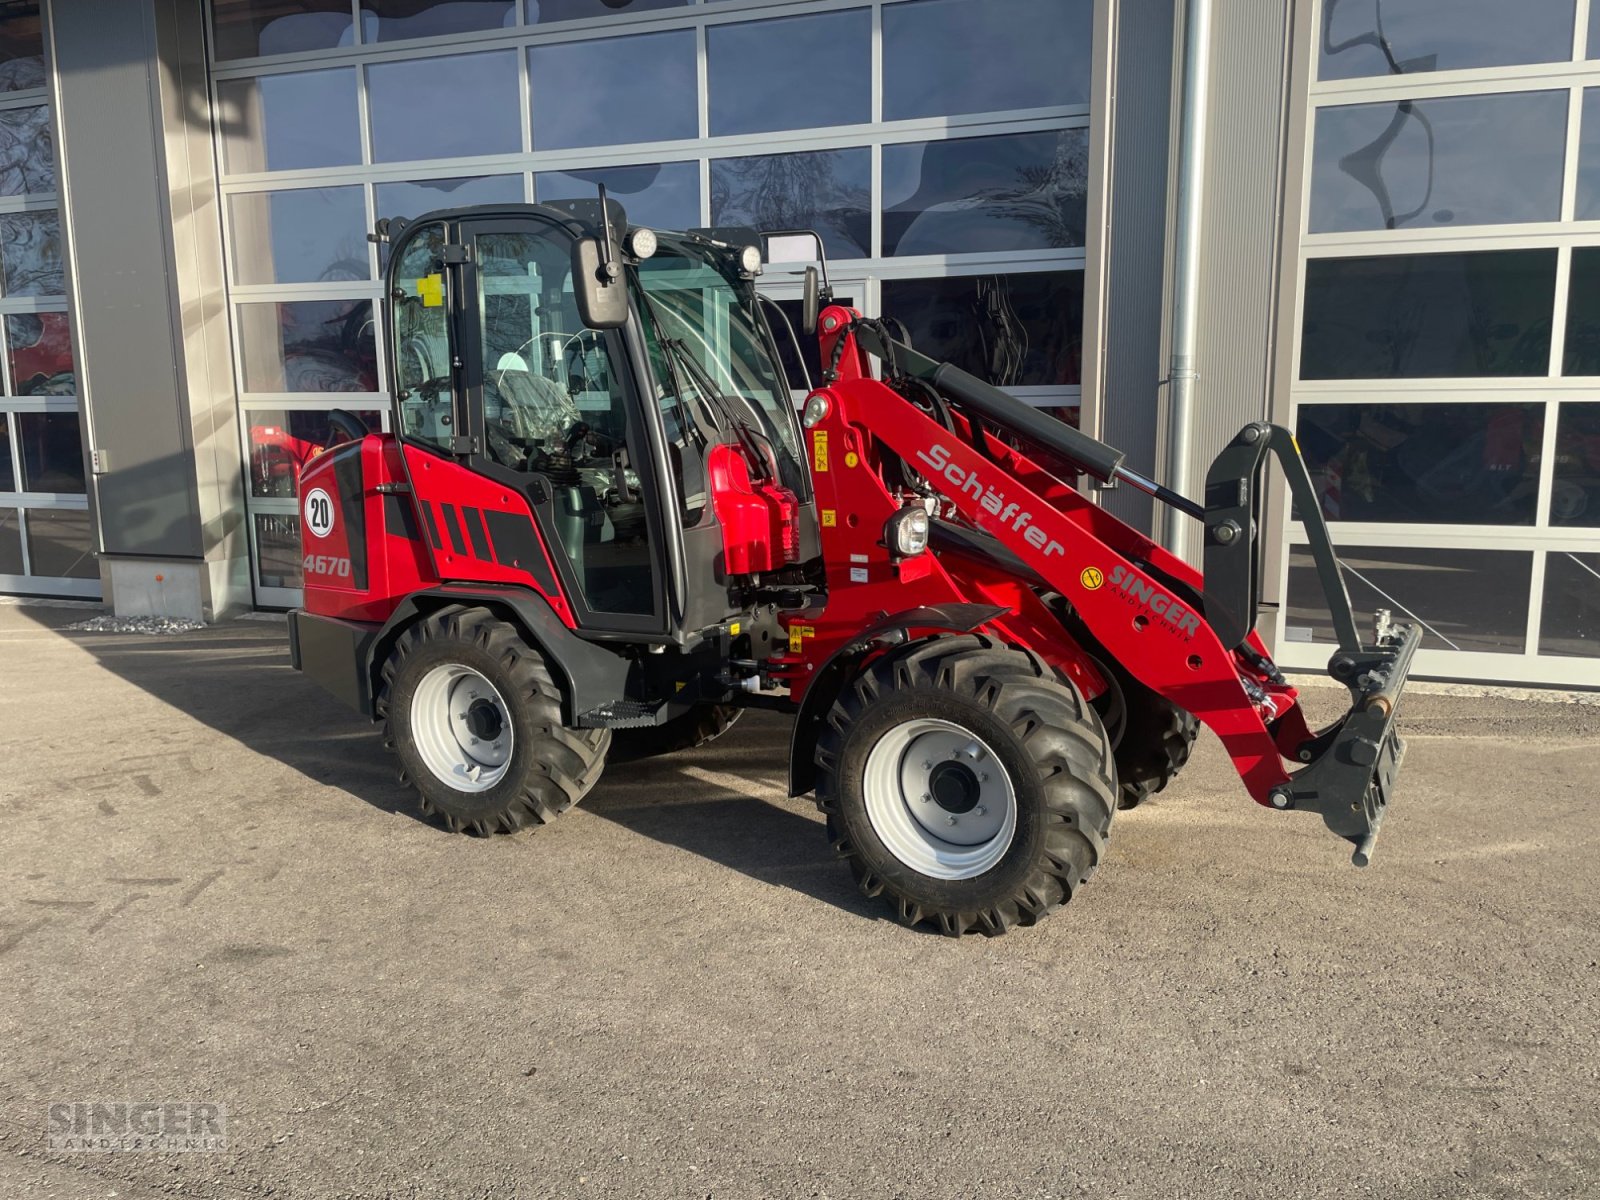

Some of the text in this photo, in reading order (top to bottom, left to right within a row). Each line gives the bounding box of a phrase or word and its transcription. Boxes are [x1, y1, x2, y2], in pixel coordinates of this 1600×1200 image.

[311, 498, 329, 528] 20
[916, 444, 1065, 557] Schäffer
[303, 554, 351, 577] 4670
[1102, 581, 1191, 643] LANDTECHNIK
[1108, 565, 1201, 637] SINGER
